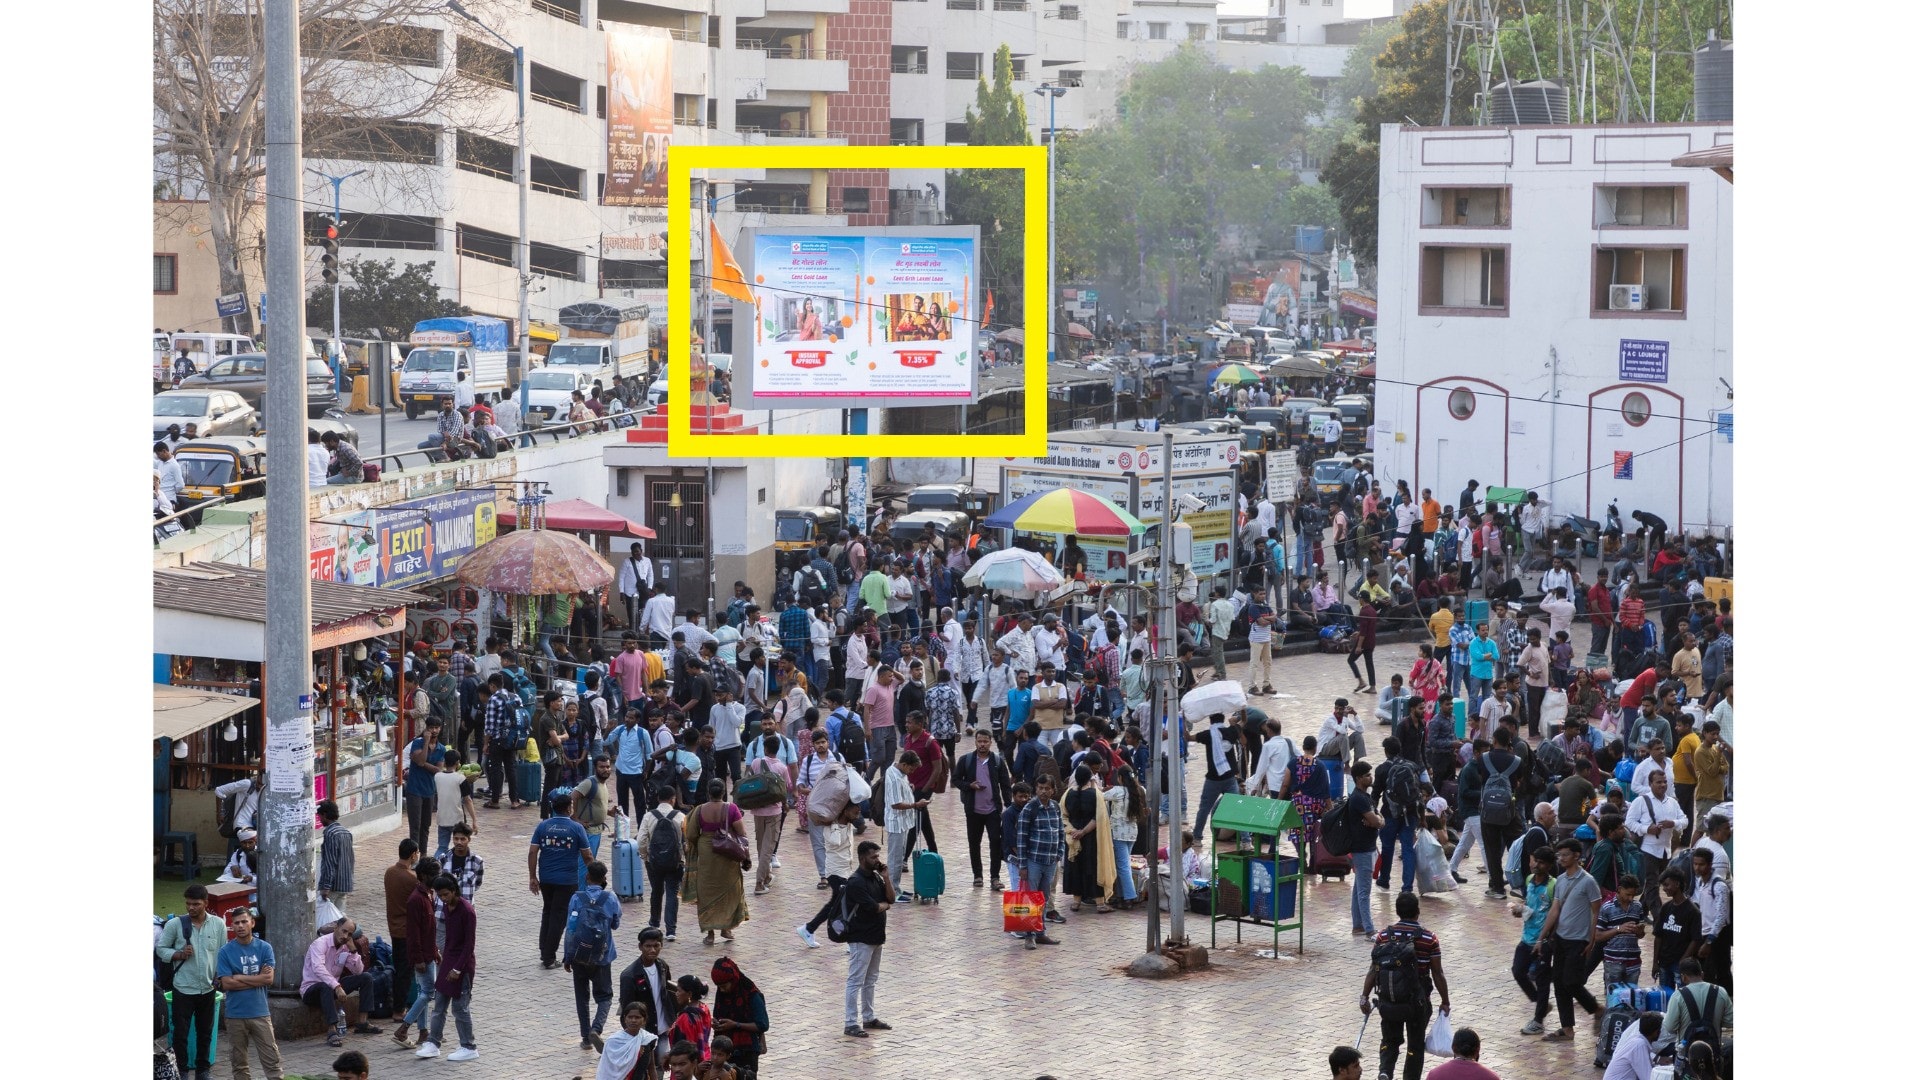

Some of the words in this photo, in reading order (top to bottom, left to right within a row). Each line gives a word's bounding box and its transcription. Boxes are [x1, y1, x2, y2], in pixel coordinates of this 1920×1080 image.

[907, 356, 928, 364] 7.35%
[1328, 426, 1333, 434] 7
[1033, 455, 1056, 465] Prepaid
[1057, 456, 1071, 467] Auto
[1071, 457, 1101, 469] Rickshaw
[392, 527, 424, 556] EXIT
[393, 554, 422, 574] बाहेर
[1611, 1020, 1623, 1051] adidas
